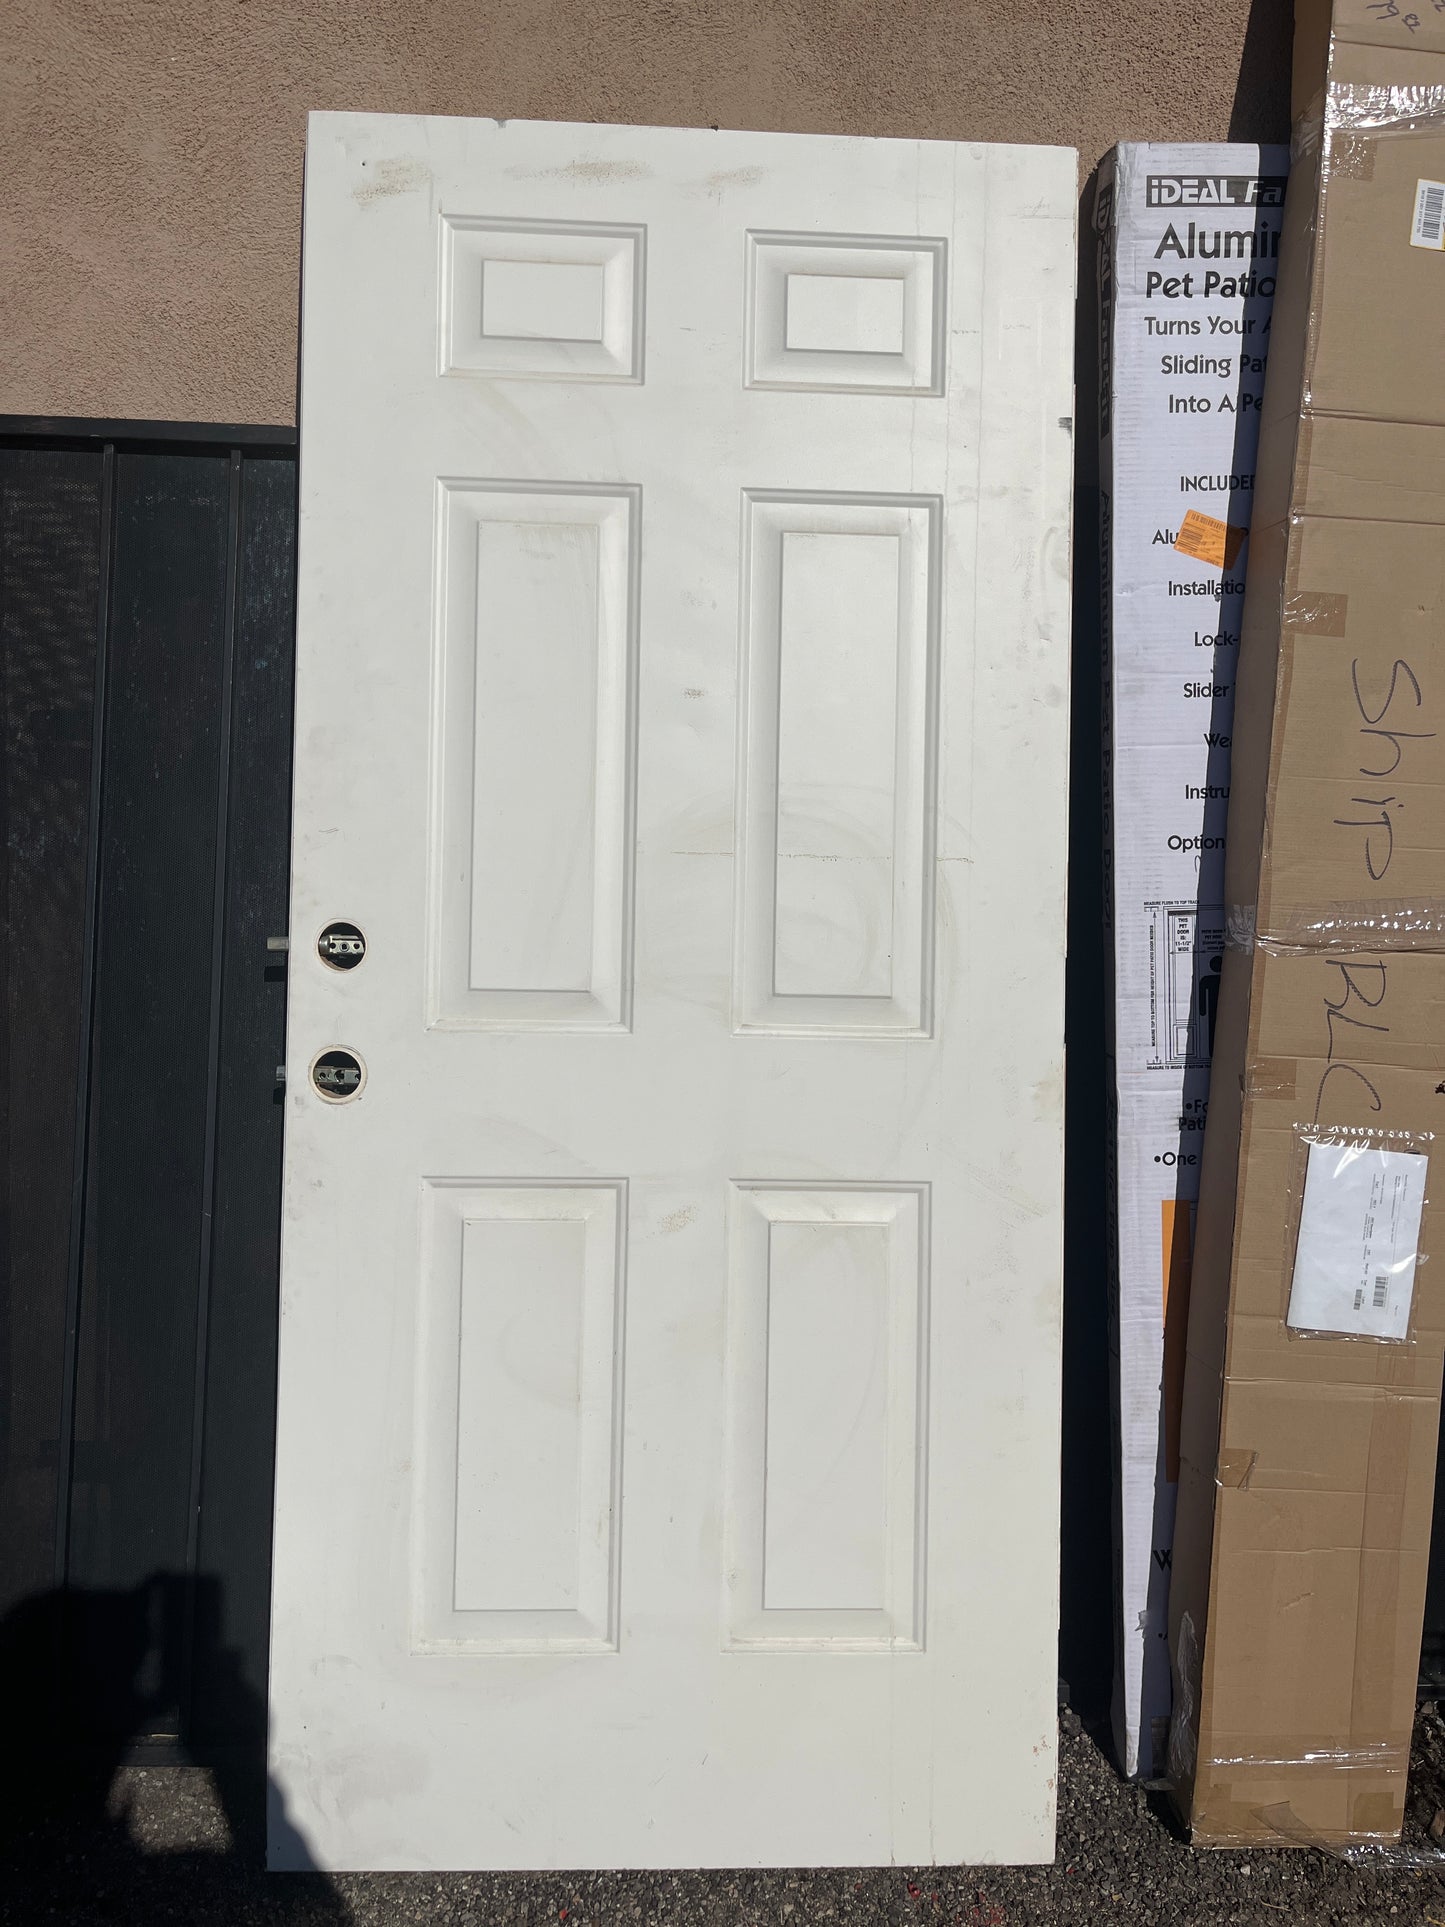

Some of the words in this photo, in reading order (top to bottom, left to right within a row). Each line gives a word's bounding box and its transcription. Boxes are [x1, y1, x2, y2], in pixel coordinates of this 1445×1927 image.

[1146, 271, 1193, 298] Pet
[1204, 269, 1276, 298] Patio
[1144, 316, 1200, 335] Turns
[1207, 315, 1256, 335] Your
[1161, 355, 1232, 378] Sliding
[1168, 393, 1211, 413] Into
[1217, 394, 1235, 412] A
[1194, 631, 1239, 647] Lock-
[1183, 682, 1229, 698] Slider
